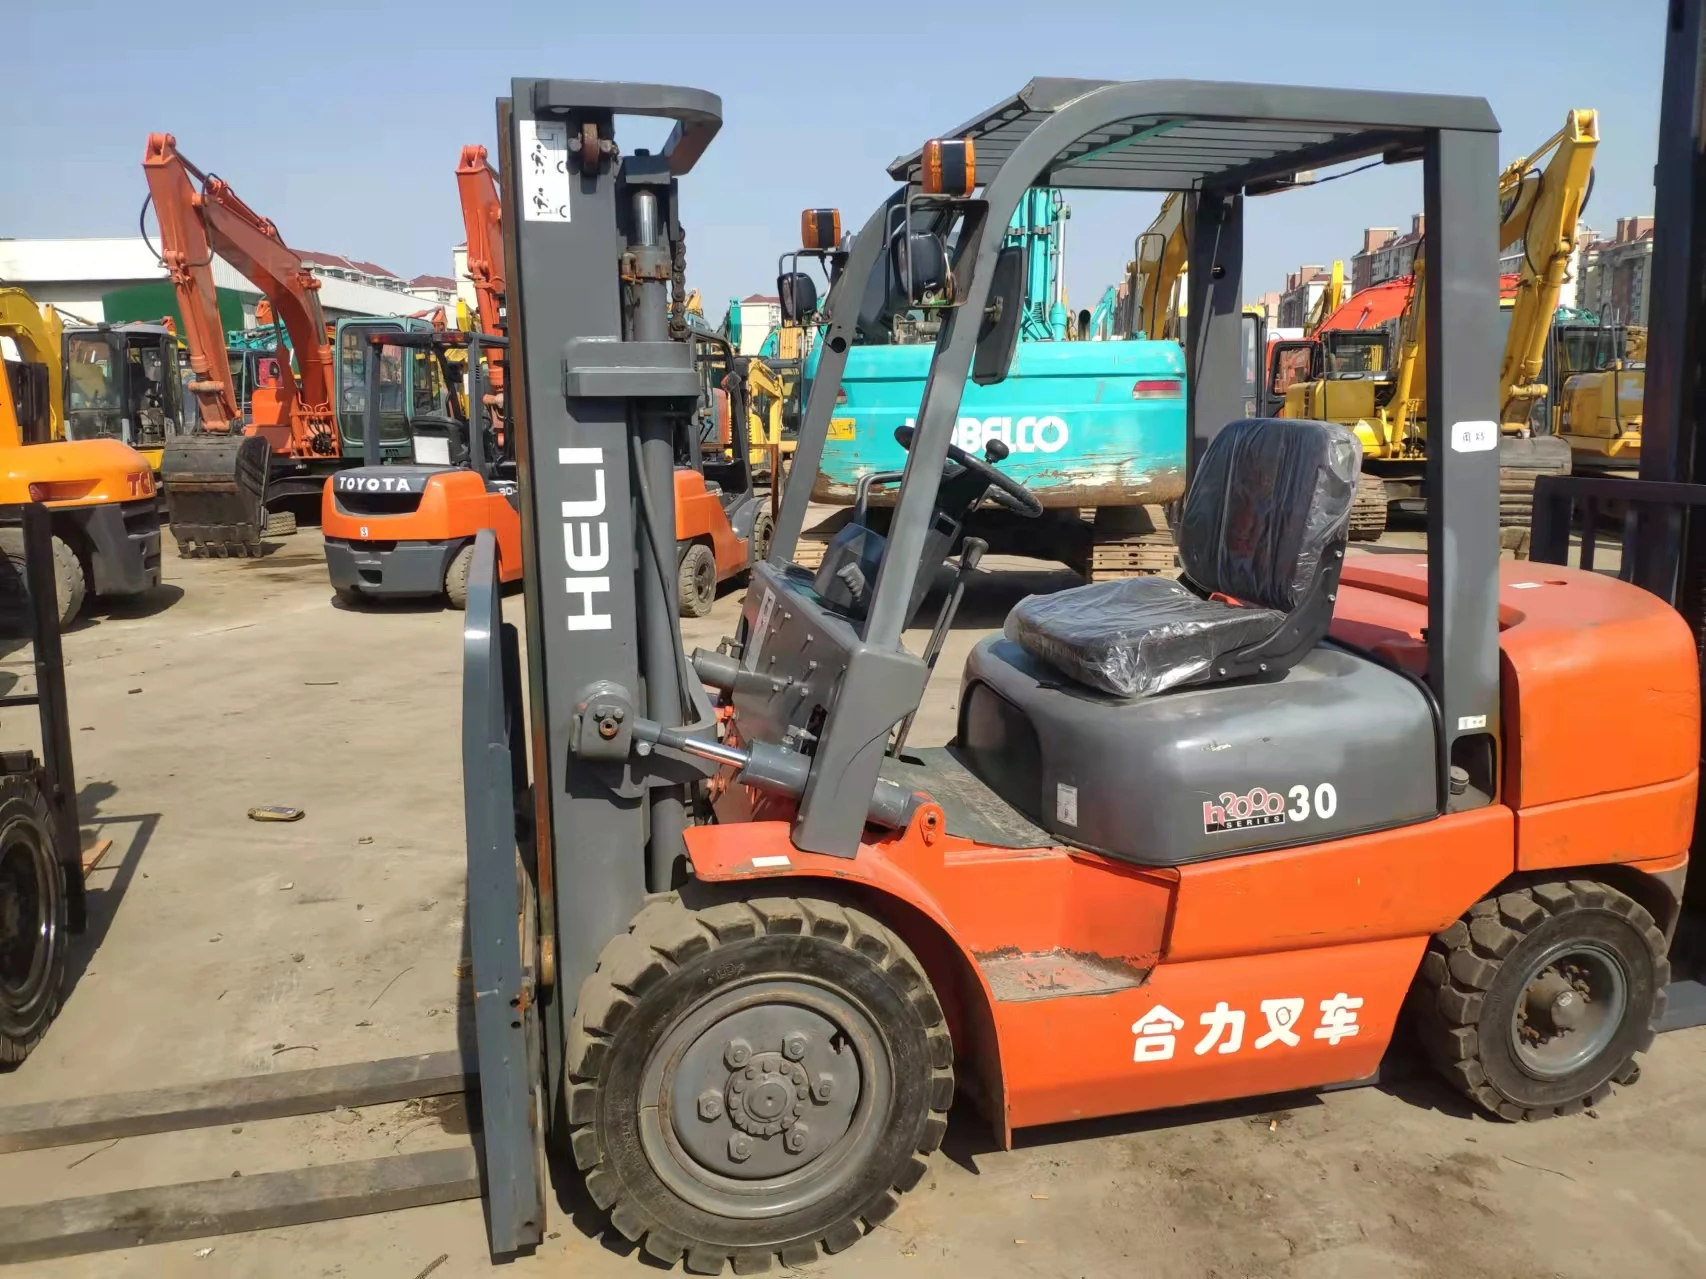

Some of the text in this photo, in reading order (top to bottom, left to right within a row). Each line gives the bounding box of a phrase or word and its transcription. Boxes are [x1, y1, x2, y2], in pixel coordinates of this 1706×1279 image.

[906, 416, 1069, 453] BELCO
[339, 476, 411, 491] TOYOTA
[558, 447, 612, 631] HELI
[1287, 782, 1338, 822] 30
[1225, 815, 1281, 829] SERIES
[1131, 992, 1365, 1063] 合力叉车
